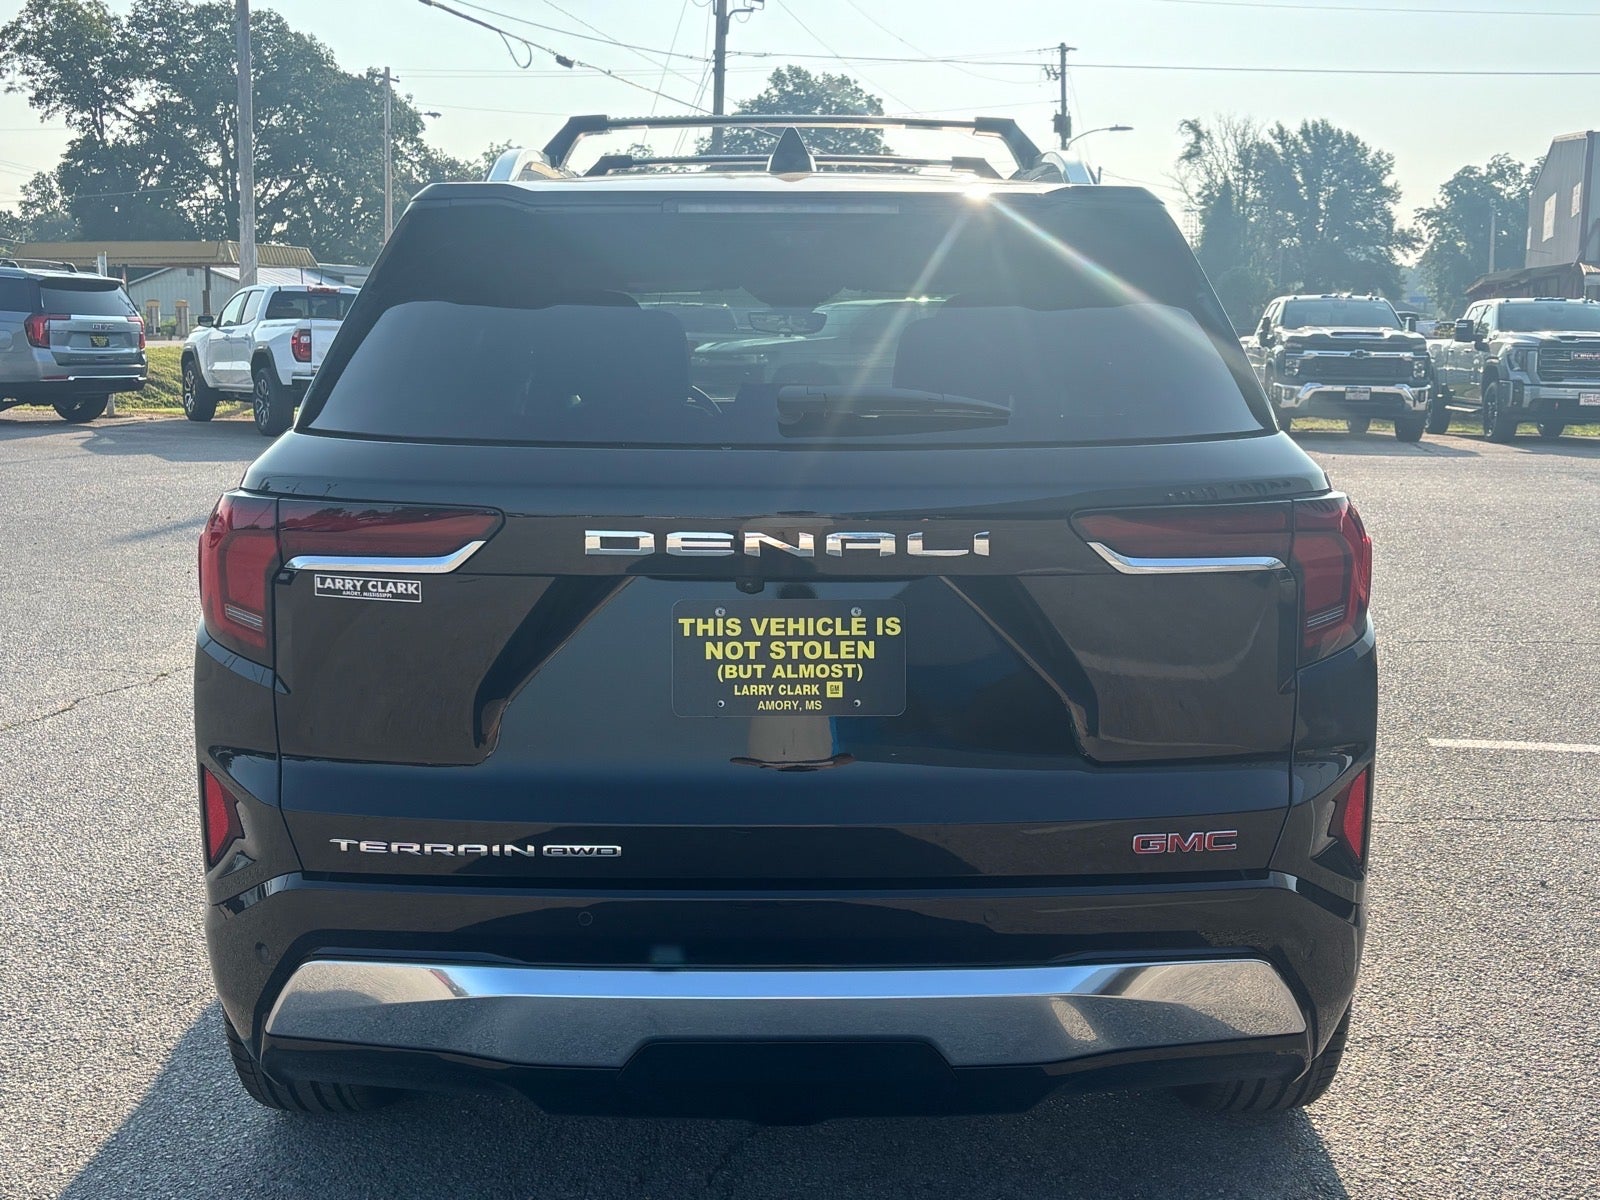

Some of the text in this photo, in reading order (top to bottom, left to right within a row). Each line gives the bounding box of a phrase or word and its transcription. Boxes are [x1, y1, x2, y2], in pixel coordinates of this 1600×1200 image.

[585, 530, 990, 557] DENALI
[316, 577, 419, 594] LARRY CLARK
[678, 617, 902, 637] THIS VEHICLE IS
[705, 640, 875, 660] NOT STOLEN
[717, 663, 864, 682] (BUT ALMOST)
[734, 684, 774, 696] LARRY
[778, 684, 820, 695] CLARK
[757, 699, 823, 711] AMORY, MS
[329, 838, 622, 857] TERRAIN AWD
[1132, 830, 1238, 854] GMC
